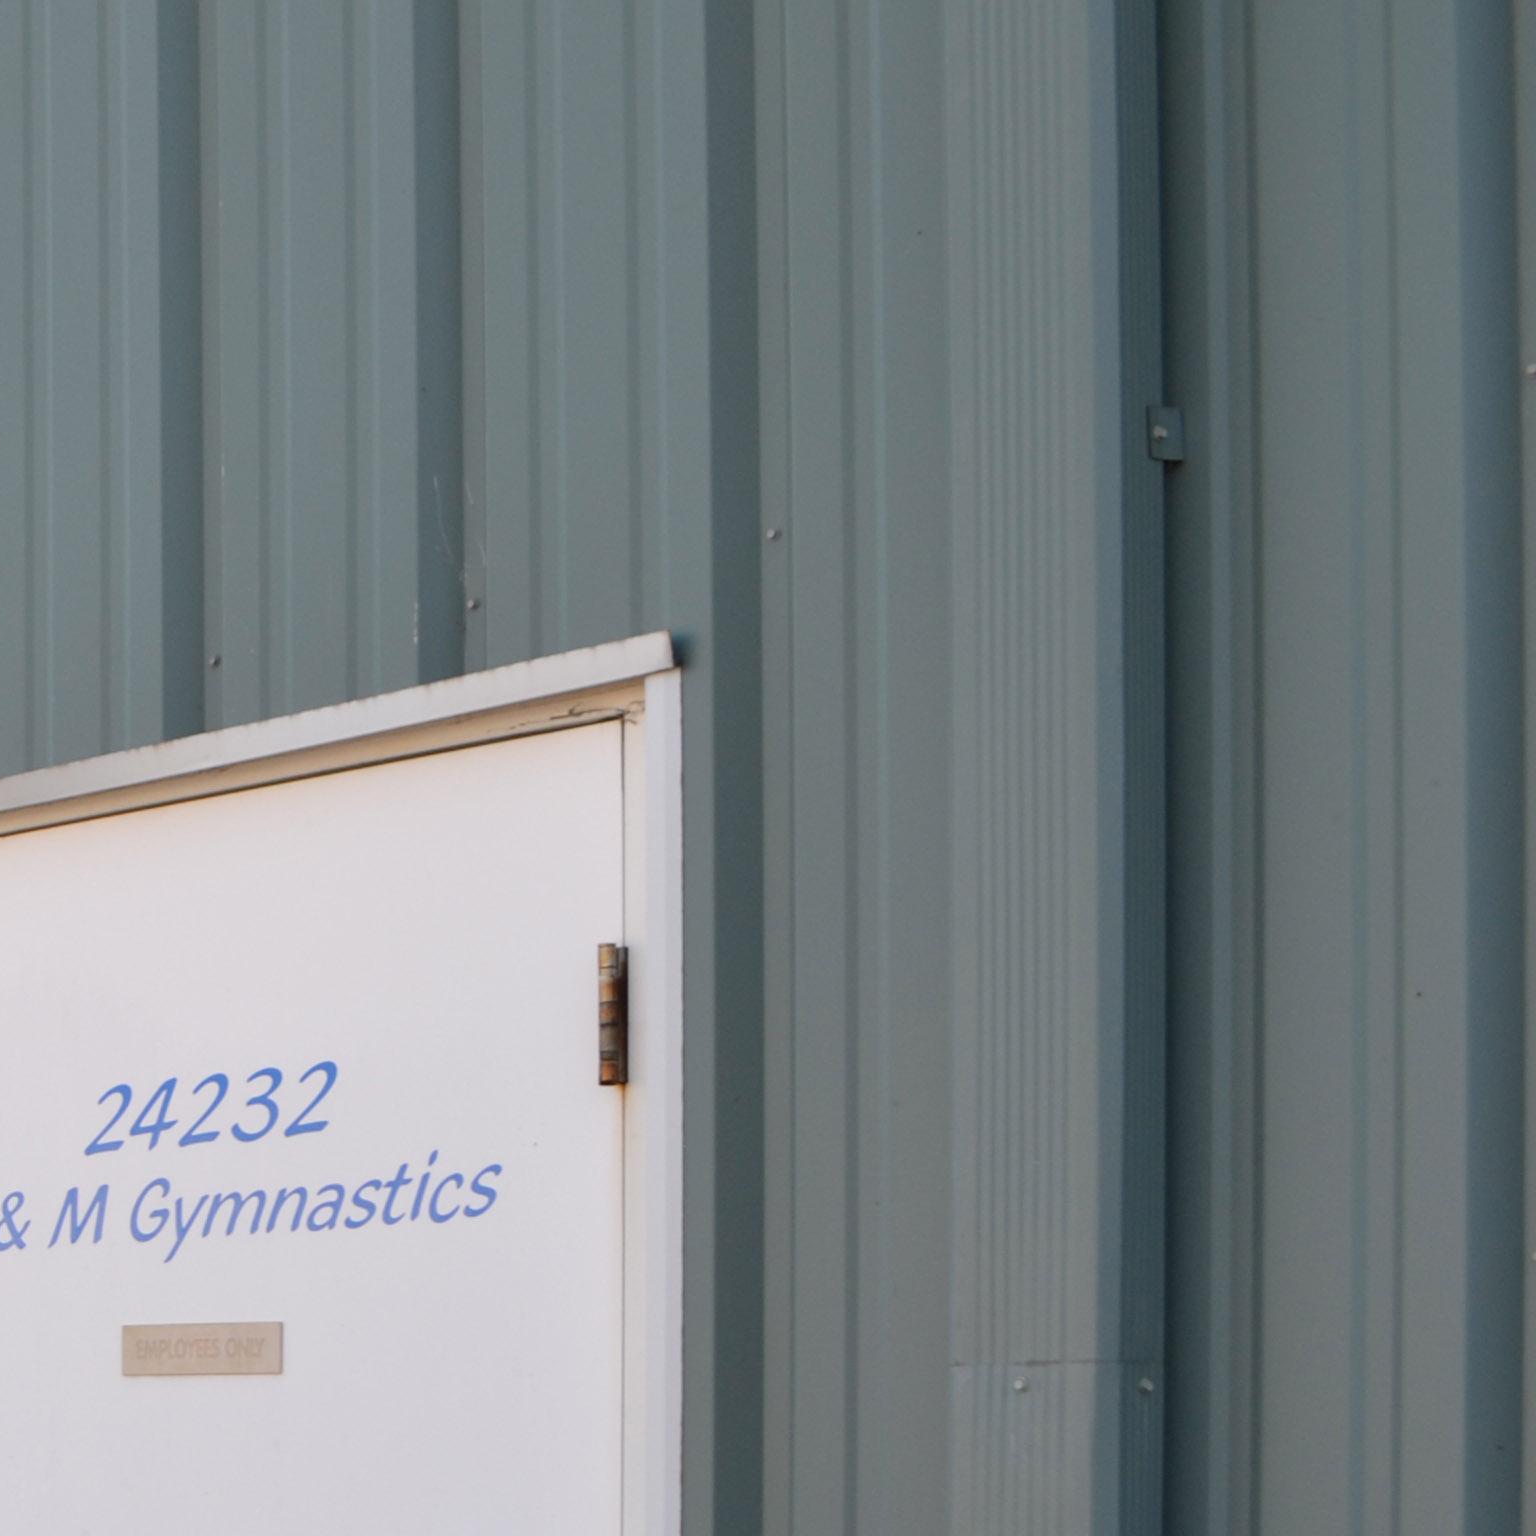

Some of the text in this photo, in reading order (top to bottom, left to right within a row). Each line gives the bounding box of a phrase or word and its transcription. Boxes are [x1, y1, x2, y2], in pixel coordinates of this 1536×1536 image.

[84, 1060, 339, 1156] 24232
[49, 1183, 110, 1248] M
[130, 1150, 504, 1263] Gymnastics
[134, 1335, 267, 1361] EMPLOYEES ONLY
